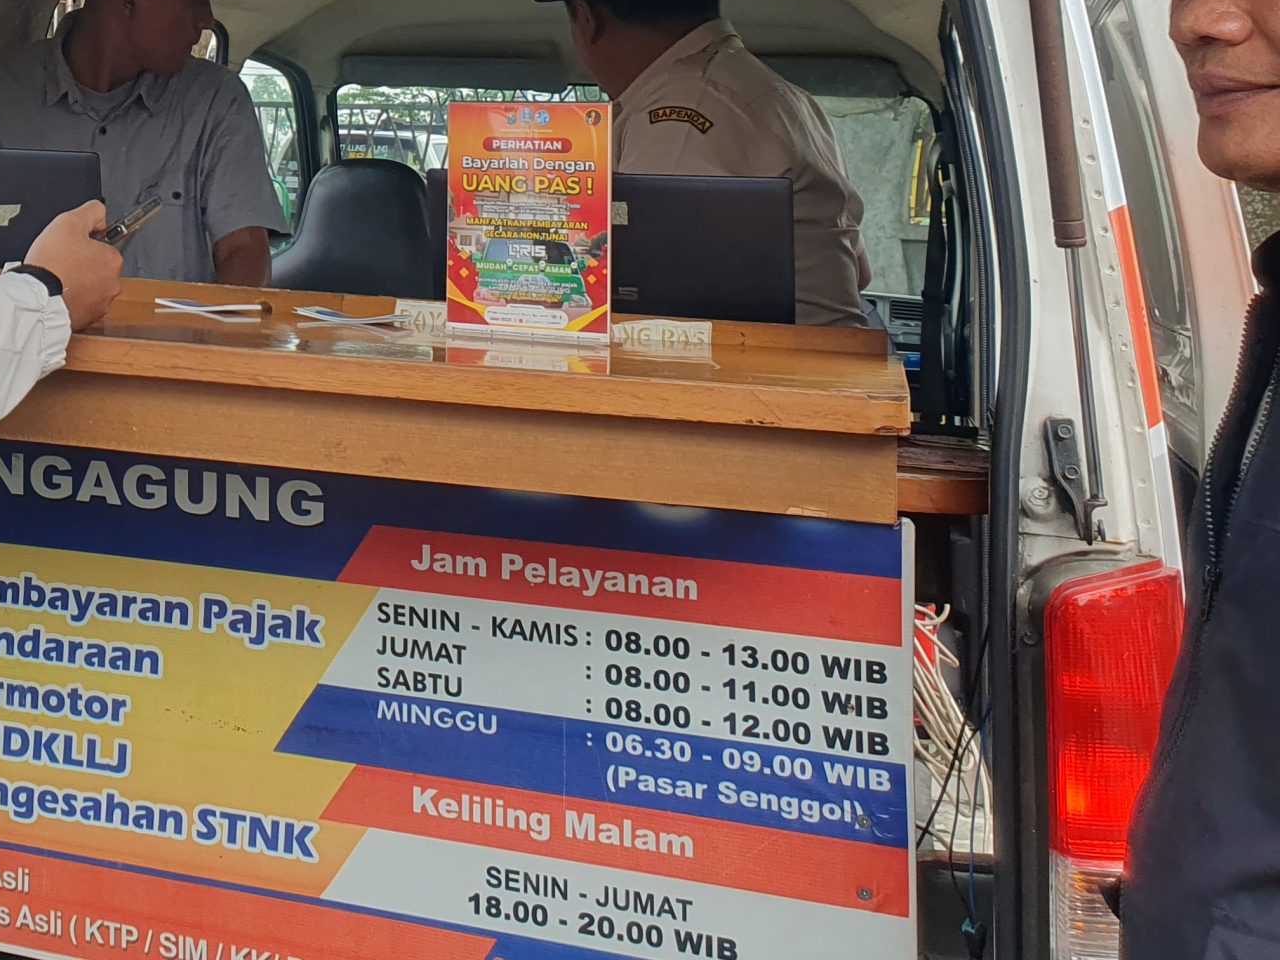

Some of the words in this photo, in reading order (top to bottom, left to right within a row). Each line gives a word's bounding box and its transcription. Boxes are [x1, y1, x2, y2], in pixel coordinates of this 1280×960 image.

[492, 140, 562, 151] PERHATIAN
[652, 108, 709, 130] BAPENDA
[462, 156, 528, 171] Bayarlah
[534, 158, 595, 174] Dengan
[462, 173, 527, 193] UANG
[535, 176, 580, 194] PAS
[466, 217, 526, 228] MANFAATKAN
[527, 220, 588, 230] PEMBAYARAN
[485, 230, 520, 240] SECARA
[477, 261, 507, 271] MUDAH
[513, 263, 539, 273] CEPAT
[545, 265, 572, 275] AMAN
[411, 544, 487, 578] Jam
[501, 553, 699, 601] Pelayanan
[202, 597, 321, 645] Pajak
[377, 602, 461, 633] SENIN
[491, 616, 579, 647] KAMIS
[605, 629, 690, 660] 08.00
[722, 643, 810, 675] 13.00
[820, 654, 888, 685] WIB
[376, 635, 467, 665] JUMAT
[605, 663, 690, 694] 08.00
[722, 678, 810, 710] 11.00
[821, 690, 889, 720] WIB
[377, 666, 463, 698] SABTU
[605, 697, 691, 729] 08.00
[723, 712, 811, 745] 12.00
[822, 725, 890, 756] WIB
[376, 700, 498, 735] MINGGU
[605, 731, 692, 763] 06.30
[722, 747, 813, 781] 09.00
[823, 761, 892, 792] WIB
[412, 786, 551, 840] Keliling
[565, 810, 694, 858] Malam
[606, 765, 708, 801] (Pasar
[717, 780, 866, 828] Senggol)
[196, 808, 315, 859] STNK
[486, 866, 568, 901] SENIN
[595, 885, 693, 922] JUMAT
[15, 905, 62, 936] Asli
[84, 917, 139, 949] KTP
[159, 932, 208, 960] SIM
[468, 893, 548, 927] 18.00
[577, 912, 664, 948] 20.00
[674, 928, 738, 960] WIB
